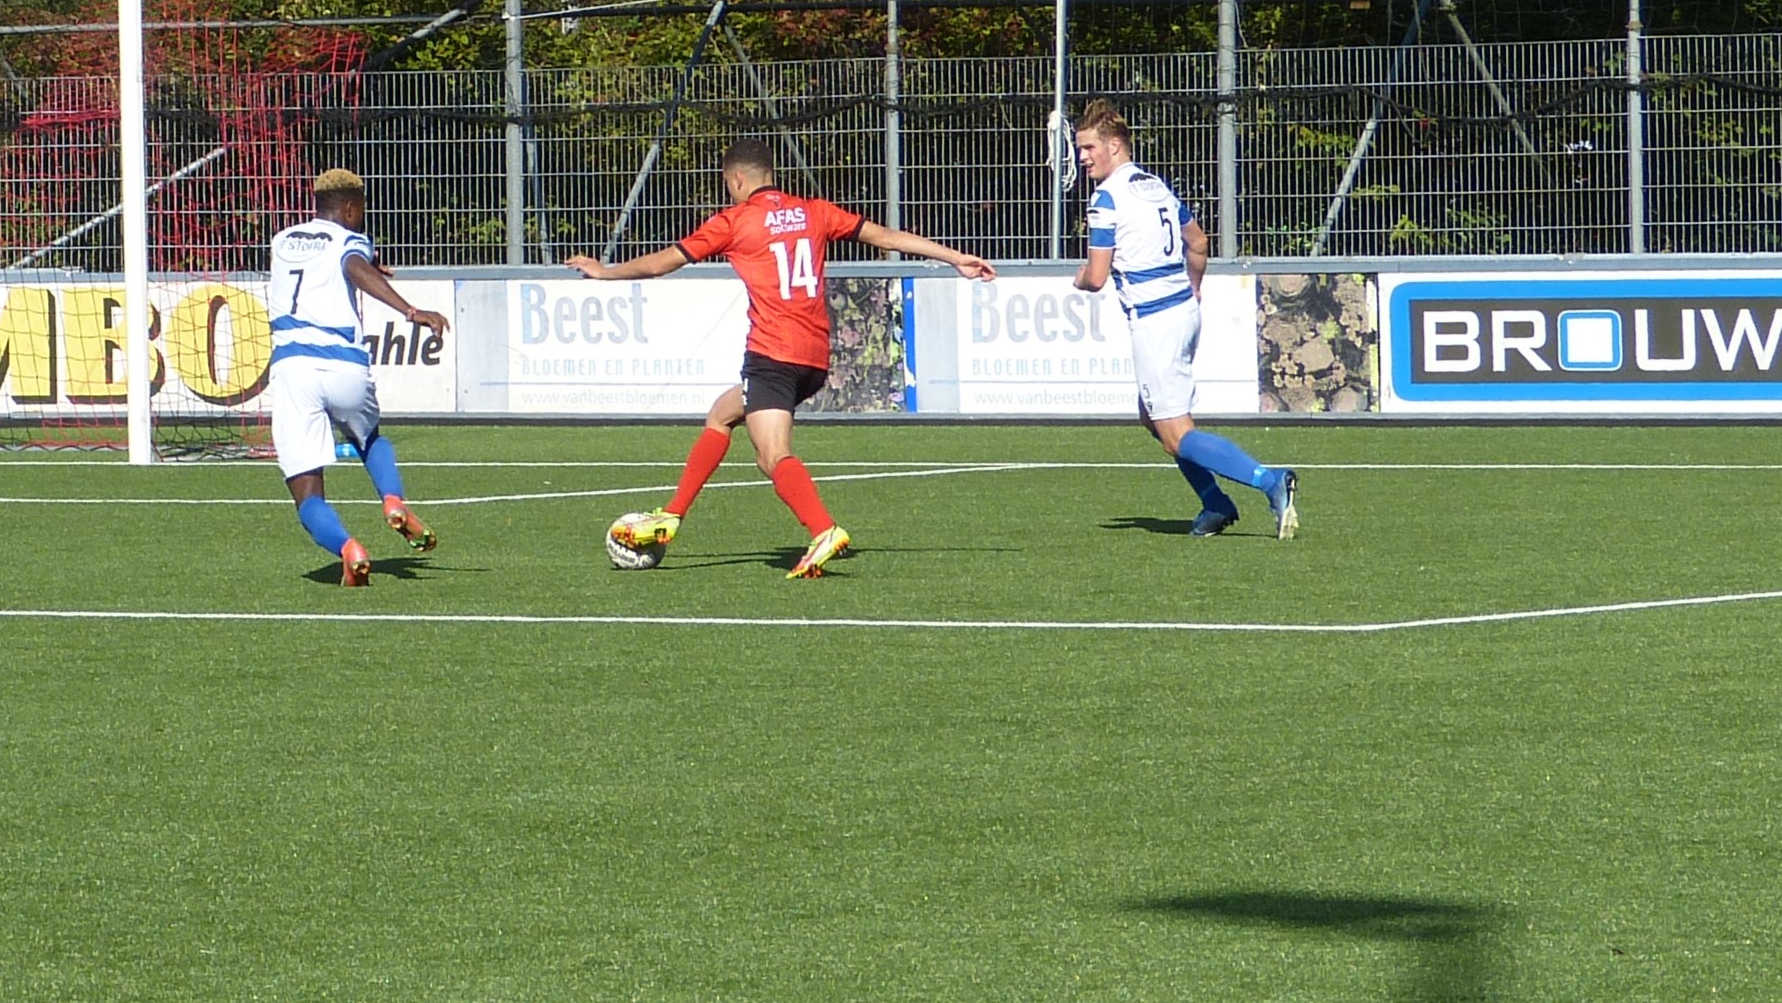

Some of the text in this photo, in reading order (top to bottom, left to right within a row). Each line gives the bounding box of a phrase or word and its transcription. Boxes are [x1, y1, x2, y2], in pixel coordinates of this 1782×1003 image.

[764, 207, 806, 227] AFAS
[1158, 207, 1174, 256] 5
[289, 269, 304, 315] 7
[769, 238, 817, 300] 14
[520, 282, 649, 344] Beest
[972, 281, 1106, 343] Beest
[1423, 309, 1782, 372] BROUW
[522, 358, 705, 375] BLOEMEN EN PLANTEN
[973, 358, 1051, 375] BLOEMEN
[1061, 358, 1079, 375] EN
